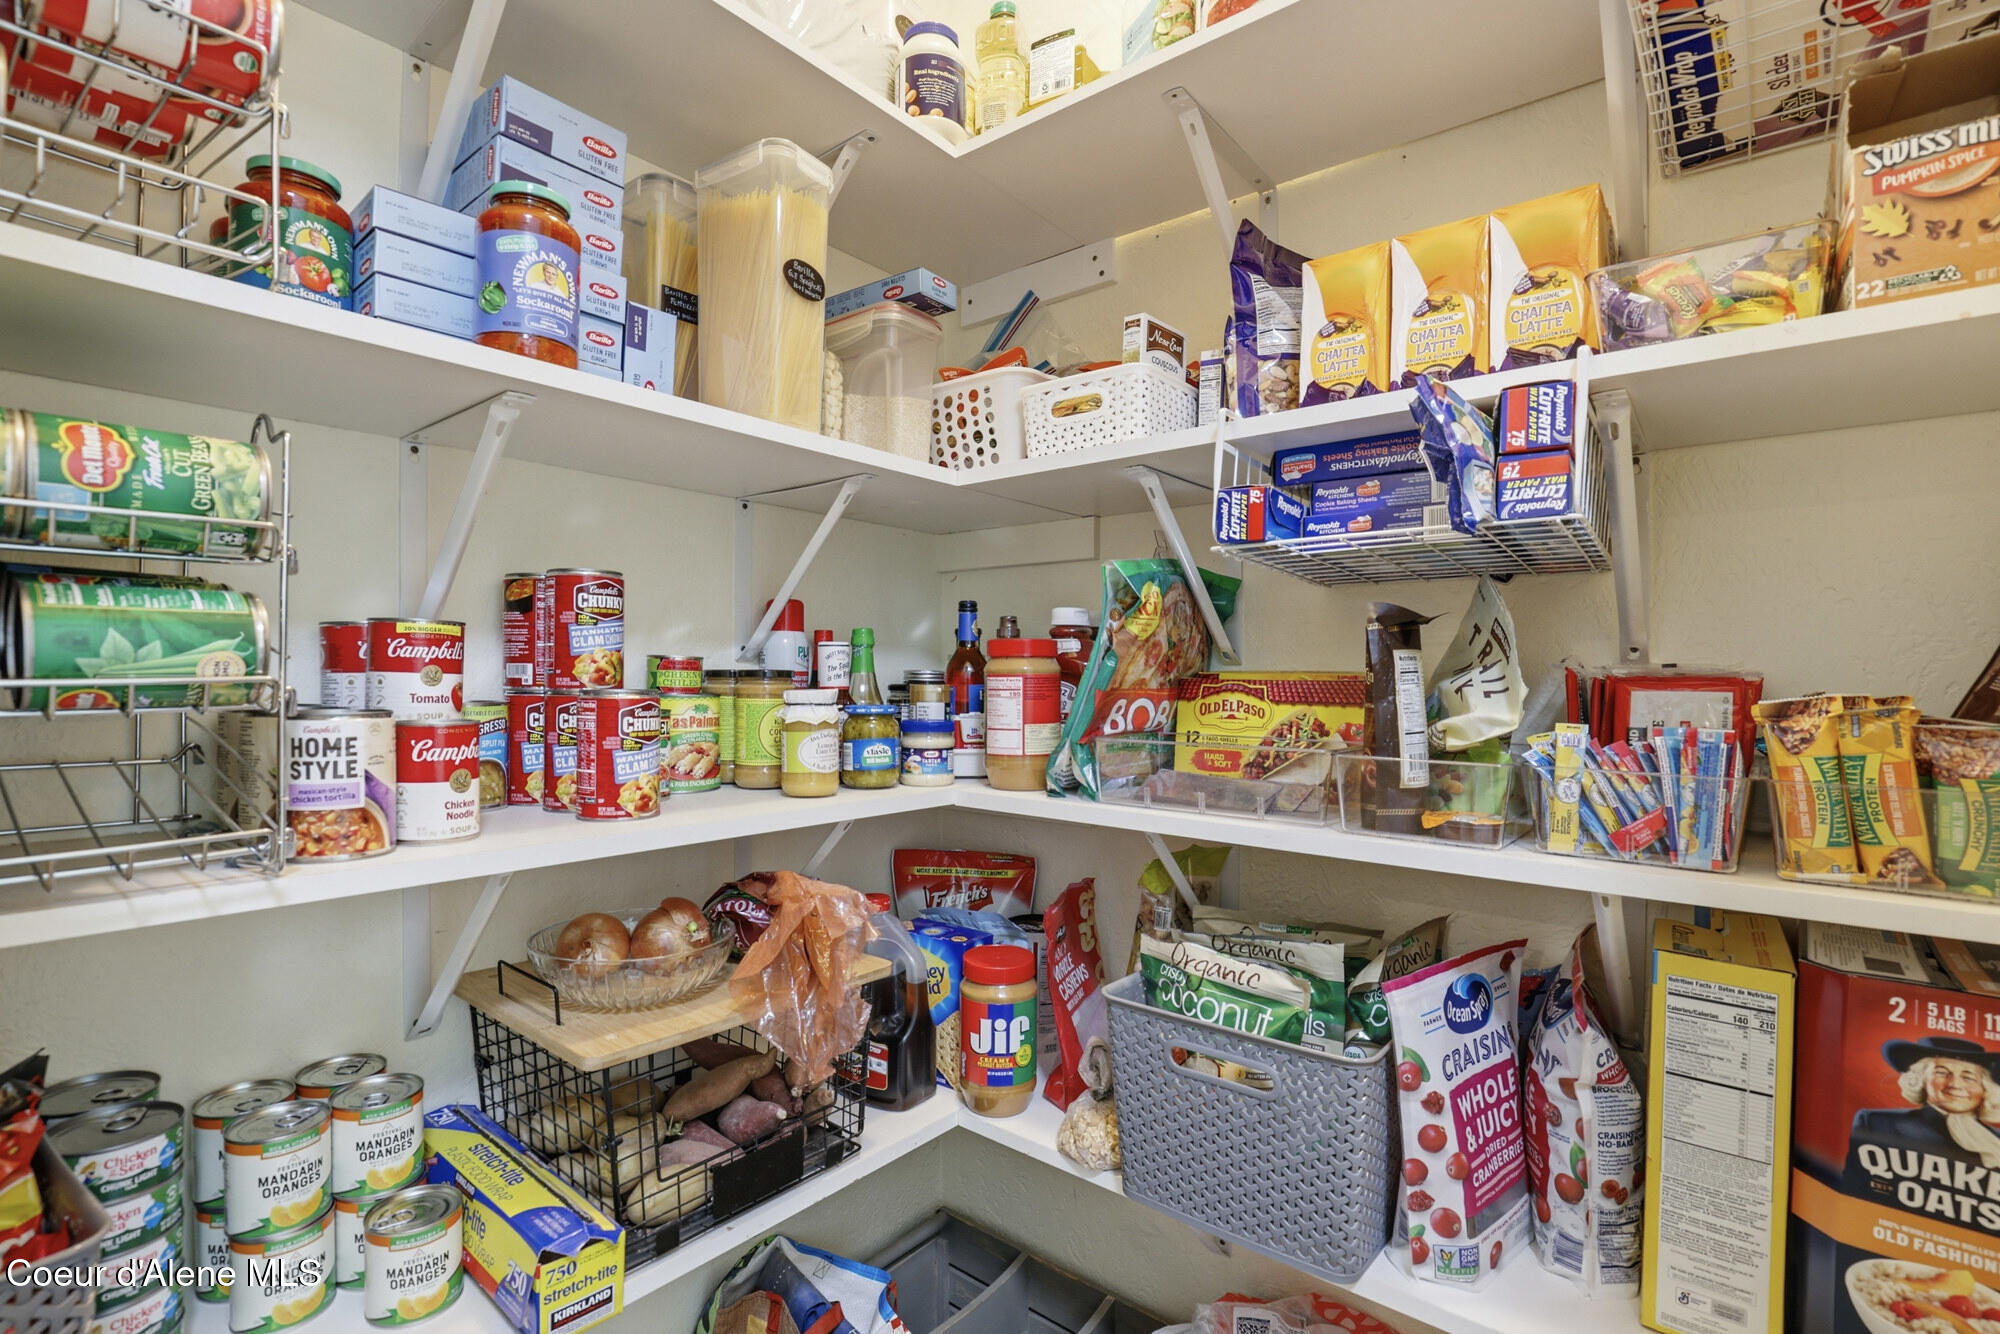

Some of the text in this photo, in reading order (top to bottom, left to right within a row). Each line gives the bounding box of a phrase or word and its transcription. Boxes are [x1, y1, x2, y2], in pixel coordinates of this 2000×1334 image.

[587, 138, 613, 157] Barilla
[1862, 128, 1953, 176] SWISS
[578, 149, 618, 174] GLUTEN FREE
[1882, 146, 1986, 190] PUMPKIN SPICE
[581, 201, 616, 220] GLUTEN FREE
[588, 193, 611, 206] Barilla
[589, 236, 612, 249] Barilla
[583, 247, 617, 264] GLUTEN FREE
[512, 250, 576, 305] NEWMAN'S OWN
[592, 285, 616, 297] Barilla
[1856, 280, 1884, 300] 22
[516, 295, 574, 321] Sockarooni
[586, 296, 620, 311] GLUTEN FREE
[1511, 301, 1572, 323] CHAI TEA
[1410, 323, 1464, 344] CHAI TEA
[1519, 316, 1563, 335] LATTE
[589, 333, 613, 345] Barilla
[1149, 329, 1170, 346] Near
[1170, 338, 1182, 352] East
[1416, 338, 1456, 355] LATTE
[583, 344, 617, 359] GLUTEN FREE
[1317, 344, 1365, 363] CHAI TEA
[1323, 358, 1358, 374] LATTE
[1529, 387, 1538, 441] WAX PAPER
[1538, 387, 1554, 445] CUT-RITE
[1556, 384, 1568, 431] Reynolds
[1512, 430, 1525, 446] 75
[80, 424, 104, 485] Del Monte
[172, 448, 192, 477] CUT
[1323, 446, 1388, 461] Baking Sheets
[131, 474, 143, 507] MADE
[191, 466, 212, 511] GREEN
[1316, 486, 1349, 499] Reynolds
[1501, 484, 1567, 501] CUT-RITE
[1507, 475, 1567, 488] WAX PAPER
[1250, 490, 1260, 504] 75
[1278, 496, 1302, 518] Reynolds
[1514, 499, 1567, 513] Reynolds
[1220, 502, 1229, 540] Reynolds
[1230, 491, 1241, 540] CUT-RITE
[1307, 522, 1341, 531] Reynolds
[578, 593, 623, 611] CHUNKY
[573, 636, 604, 647] CLAM
[1469, 623, 1509, 698] TRAIL
[410, 693, 450, 704] Tomato
[1200, 699, 1265, 719] OLD EL PASO
[290, 736, 358, 758] HOME
[1186, 730, 1200, 747] 12
[290, 759, 359, 781] STYLE
[617, 760, 649, 774] CLAM
[1215, 759, 1232, 768] SOFT
[292, 792, 356, 804] chicken tortilla
[298, 785, 347, 795] mexican-style
[1866, 778, 1884, 823] PROTEIN
[445, 800, 475, 809] Chicken
[447, 810, 474, 820] Noodle
[450, 825, 472, 833] SOUP
[1971, 800, 1984, 852] CRUNCHY
[931, 885, 989, 908] French's
[1053, 952, 1075, 983] WHOLE
[1160, 963, 1187, 986] crispy
[1171, 941, 1261, 991] Organic
[1059, 963, 1089, 1001] CASHEWS
[1668, 976, 1694, 986] Nutrition
[1695, 981, 1712, 989] Facts
[1718, 985, 1736, 994] Datos
[1158, 979, 1274, 1037] coconut
[1447, 986, 1490, 1024] Ocean Spray
[1888, 996, 1906, 1024] 2
[1927, 1002, 1966, 1022] 5 LB
[1423, 1015, 1444, 1027] FARMER
[1733, 1016, 1748, 1025] 140
[1760, 1021, 1775, 1030] 210
[1927, 1017, 1965, 1035] BAGS
[970, 1016, 1030, 1054] Jif
[1457, 1070, 1517, 1122] WHOLE
[430, 1108, 456, 1126] 750
[1464, 1099, 1520, 1153] & JUICY
[355, 1126, 415, 1152] MANDARIN
[359, 1138, 413, 1162] ORANGES
[1485, 1136, 1507, 1159] DRIED
[104, 1146, 157, 1170] Chicken
[119, 1161, 144, 1177] Sea
[468, 1143, 525, 1187] stretch-tite
[1472, 1137, 1525, 1188] CRANBERRIES
[134, 1168, 158, 1182] LIGHT
[258, 1156, 323, 1189] MANDARIN
[262, 1172, 321, 1199] ORANGES
[1898, 1181, 2000, 1232] OATS
[1461, 1248, 1478, 1257] NON
[1461, 1255, 1479, 1264] GMO
[1872, 1225, 2000, 1275] OLD FASHION
[386, 1251, 450, 1279] MANDARIN
[546, 1260, 577, 1285] 750
[390, 1265, 447, 1290] ORANGES
[507, 1258, 527, 1296] 750
[543, 1264, 618, 1305] stretch-tite
[553, 1287, 612, 1322] KIRKLAND
[110, 1300, 162, 1332] Chicken
